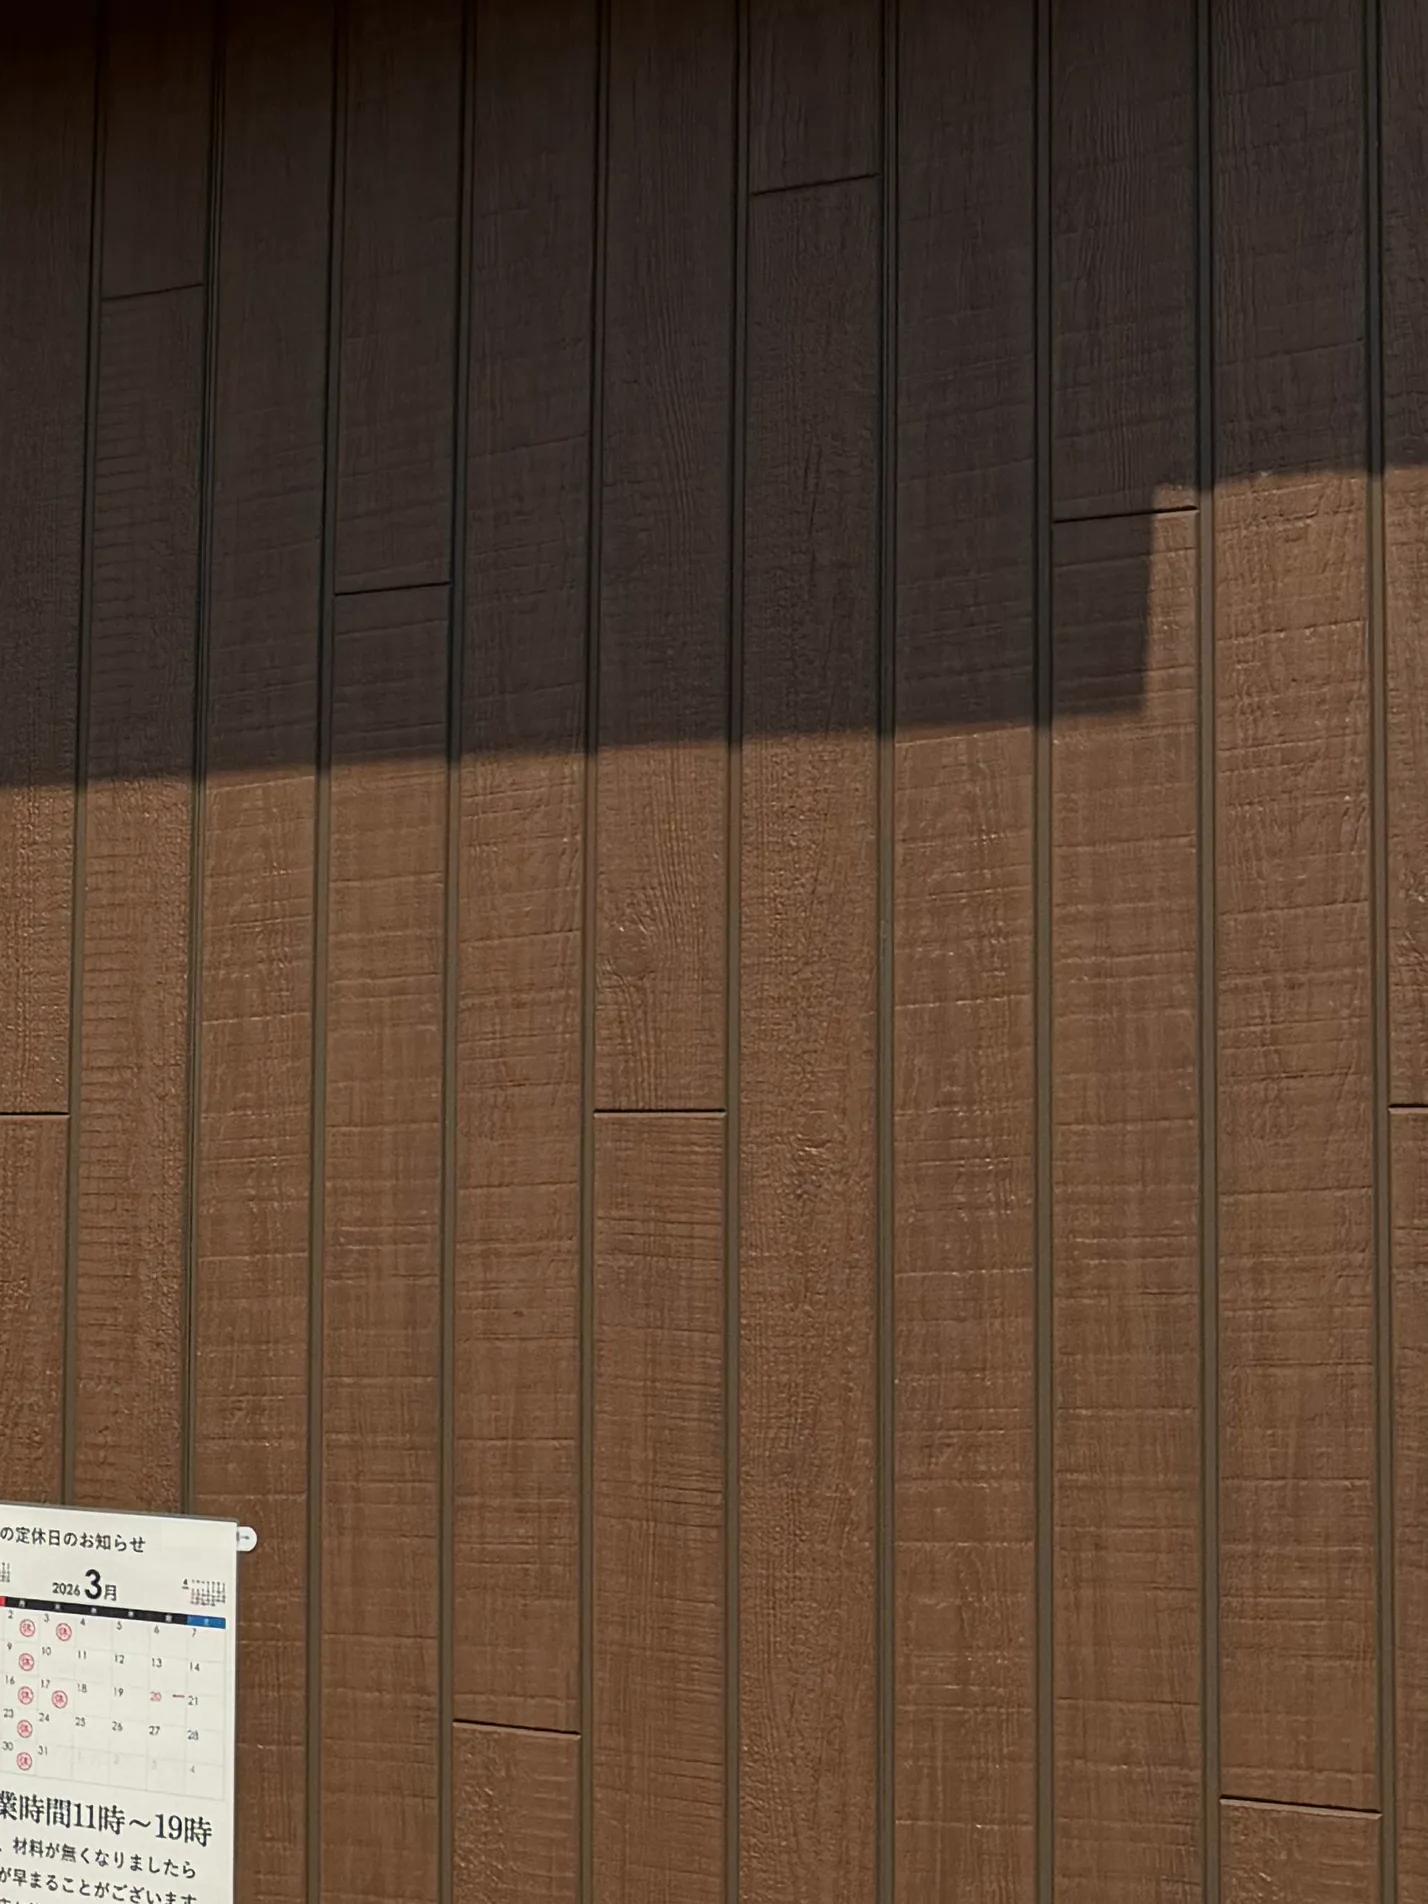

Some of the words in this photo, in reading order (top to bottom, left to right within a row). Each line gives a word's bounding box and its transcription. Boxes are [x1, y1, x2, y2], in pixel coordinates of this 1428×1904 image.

[52, 1582, 80, 1596] 2026
[84, 1569, 117, 1601] 3月
[41, 1646, 51, 1656] 10
[77, 1651, 87, 1659] 11
[115, 1654, 124, 1663] 12
[152, 1658, 162, 1668] 13
[190, 1662, 200, 1671] 14
[5, 1675, 15, 1685] 16
[41, 1680, 50, 1688] 17
[77, 1683, 87, 1693] 18
[113, 1687, 123, 1696] 19
[150, 1692, 162, 1702] 20
[188, 1696, 198, 1706] 21
[39, 1713, 49, 1722] 24
[112, 1721, 123, 1731] 26
[149, 1726, 160, 1735] 27
[3, 1741, 14, 1751] 30
[38, 1746, 48, 1755] 31
